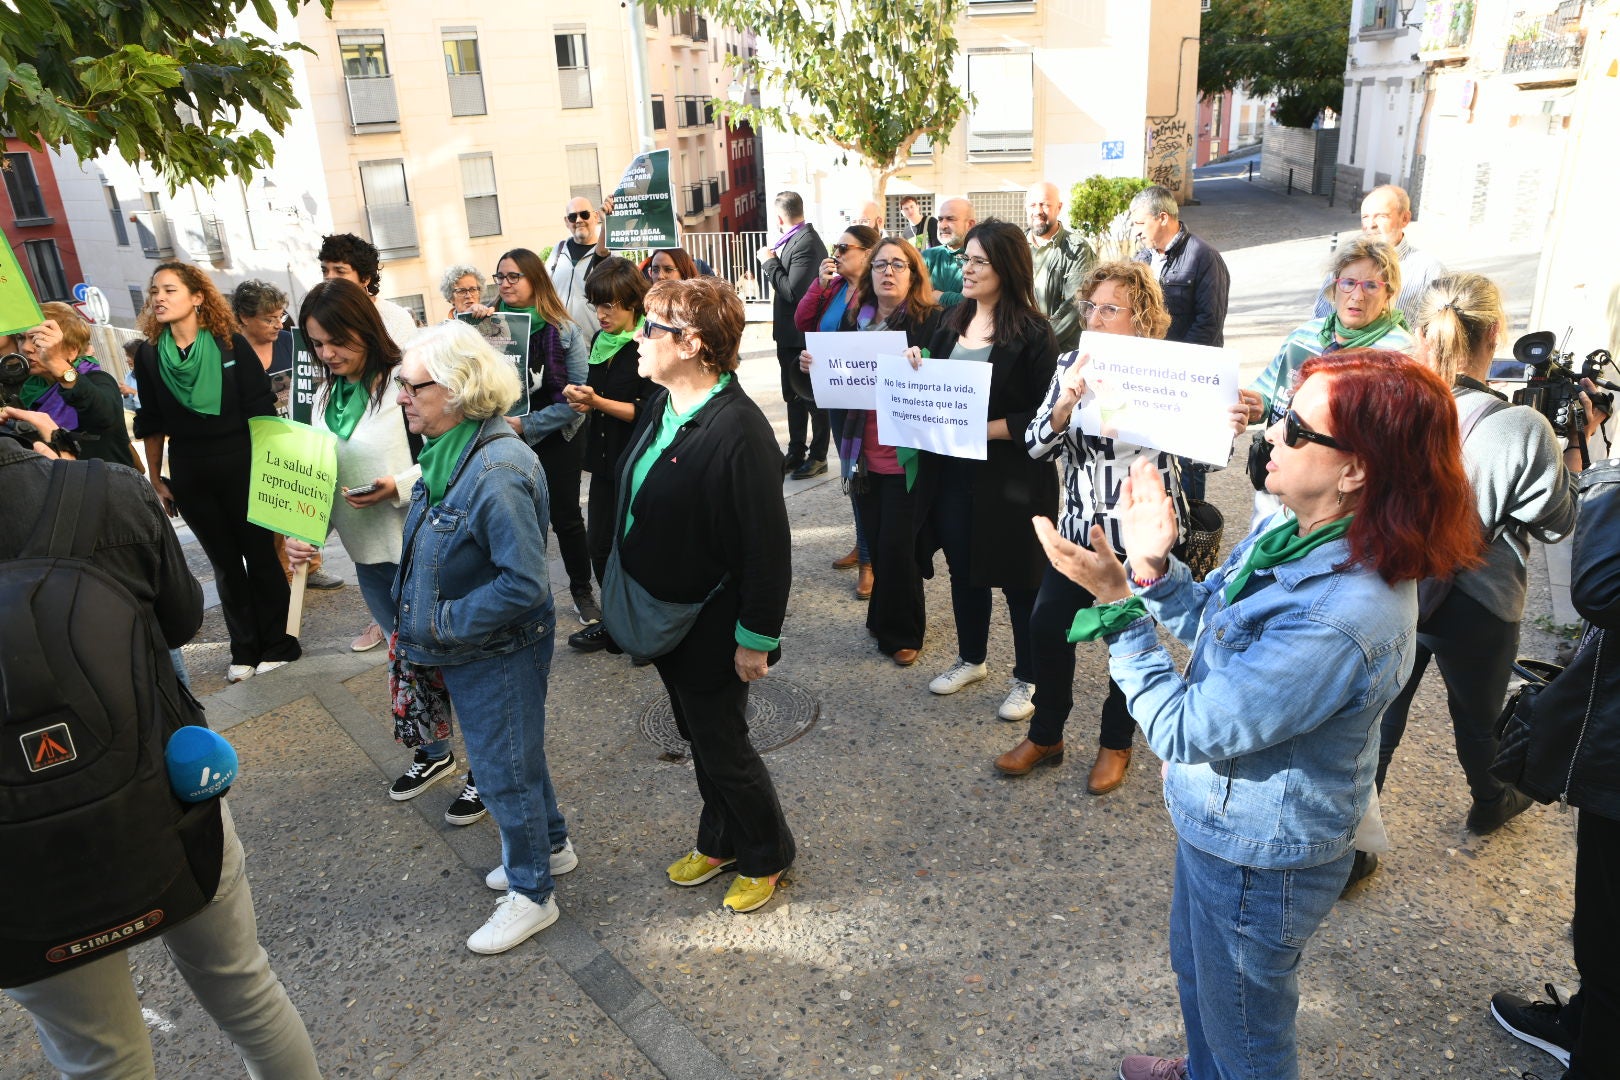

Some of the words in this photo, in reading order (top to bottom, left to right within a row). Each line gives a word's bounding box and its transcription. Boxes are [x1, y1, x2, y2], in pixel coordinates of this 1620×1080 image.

[614, 202, 628, 210] ARA
[828, 358, 842, 369] Mi
[845, 360, 878, 371] cuerp
[1092, 358, 1106, 370] La
[1109, 361, 1187, 381] maternidad
[1190, 373, 1220, 386] será
[298, 378, 312, 391] MI
[829, 375, 844, 386] mi
[847, 375, 878, 386] decisi
[884, 378, 895, 387] No
[895, 379, 906, 389] les
[908, 381, 941, 393] importa
[943, 380, 952, 392] la
[954, 382, 976, 395] vida,
[298, 391, 313, 404] DE
[1122, 381, 1176, 397] deseada
[1180, 389, 1188, 398] o
[891, 394, 901, 403] les
[902, 395, 934, 408] molesta
[936, 400, 953, 413] que
[955, 398, 968, 410] las
[1134, 399, 1149, 408] no
[1153, 402, 1182, 413] será
[892, 410, 921, 423] mujeres
[922, 411, 969, 426] decidamos
[266, 451, 280, 467] La
[283, 460, 313, 477] salud
[296, 501, 316, 518] NO
[70, 920, 145, 954] E-IMAGE
